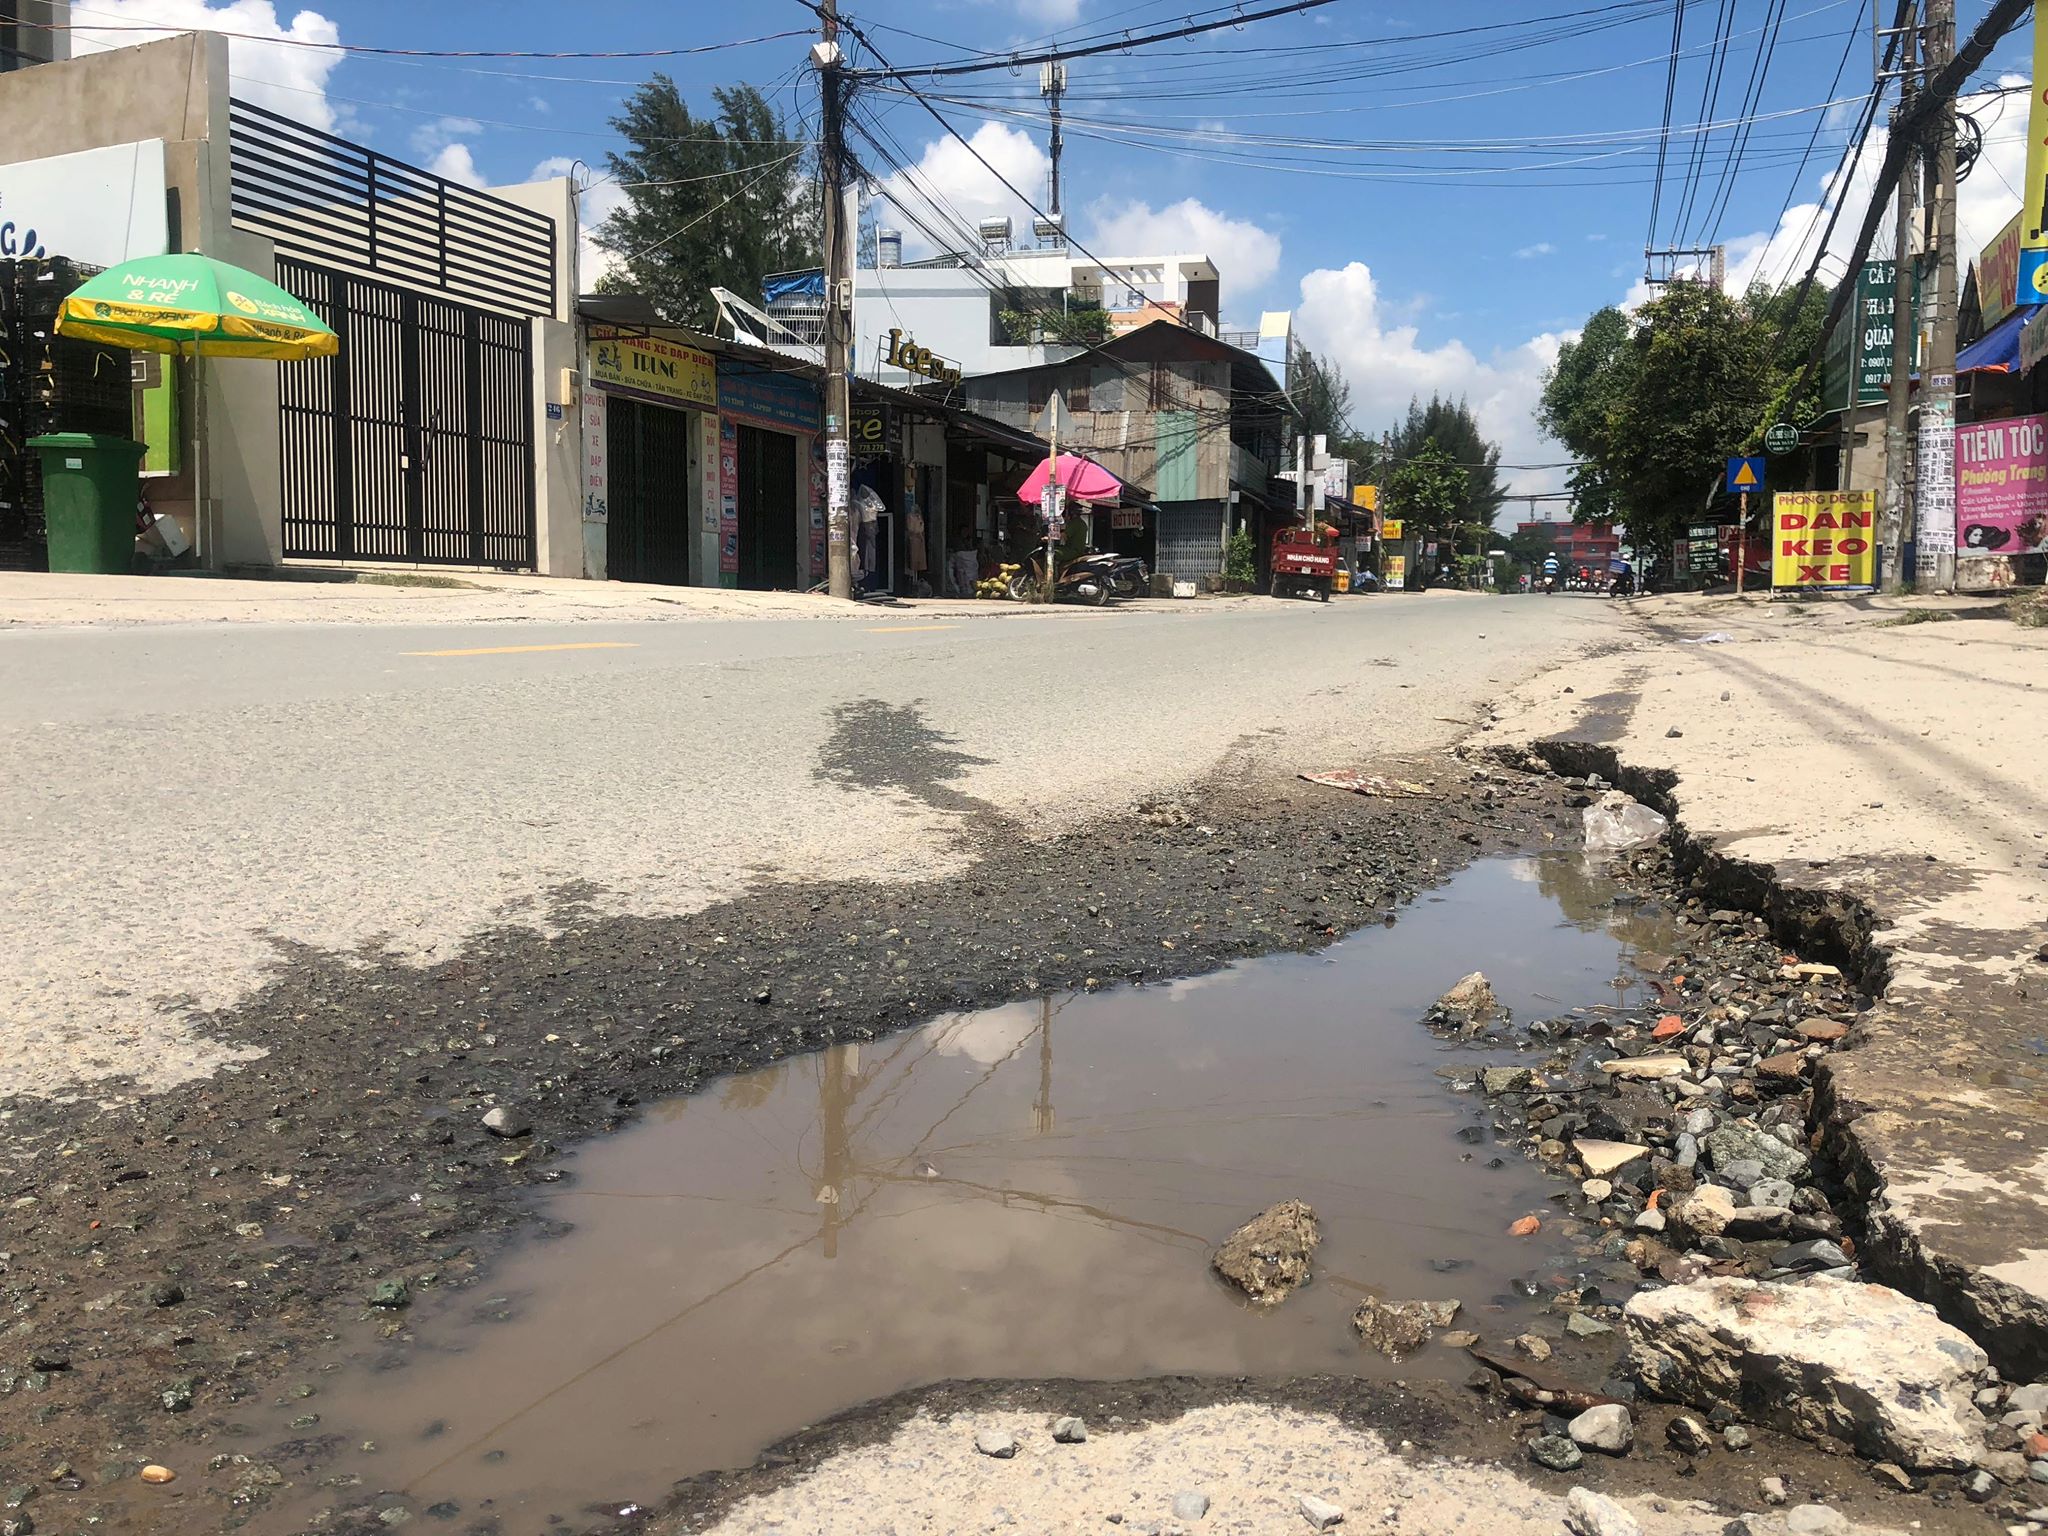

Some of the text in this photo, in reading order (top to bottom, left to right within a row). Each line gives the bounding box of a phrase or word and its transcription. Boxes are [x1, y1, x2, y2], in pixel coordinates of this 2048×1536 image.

[122, 274, 200, 291] NHANH
[1868, 263, 1884, 284] CÀ
[127, 289, 144, 300] &
[632, 351, 678, 380] TRUNG
[886, 328, 962, 390] Ice Shop
[1960, 424, 2004, 468] TIỆM
[2009, 419, 2044, 458] TÓC
[2010, 464, 2046, 482] Trang
[1779, 493, 1872, 505] PHONG DECAL
[1781, 507, 1871, 530] DÁN
[1783, 538, 1868, 556] KEO
[1796, 564, 1850, 581] XE
